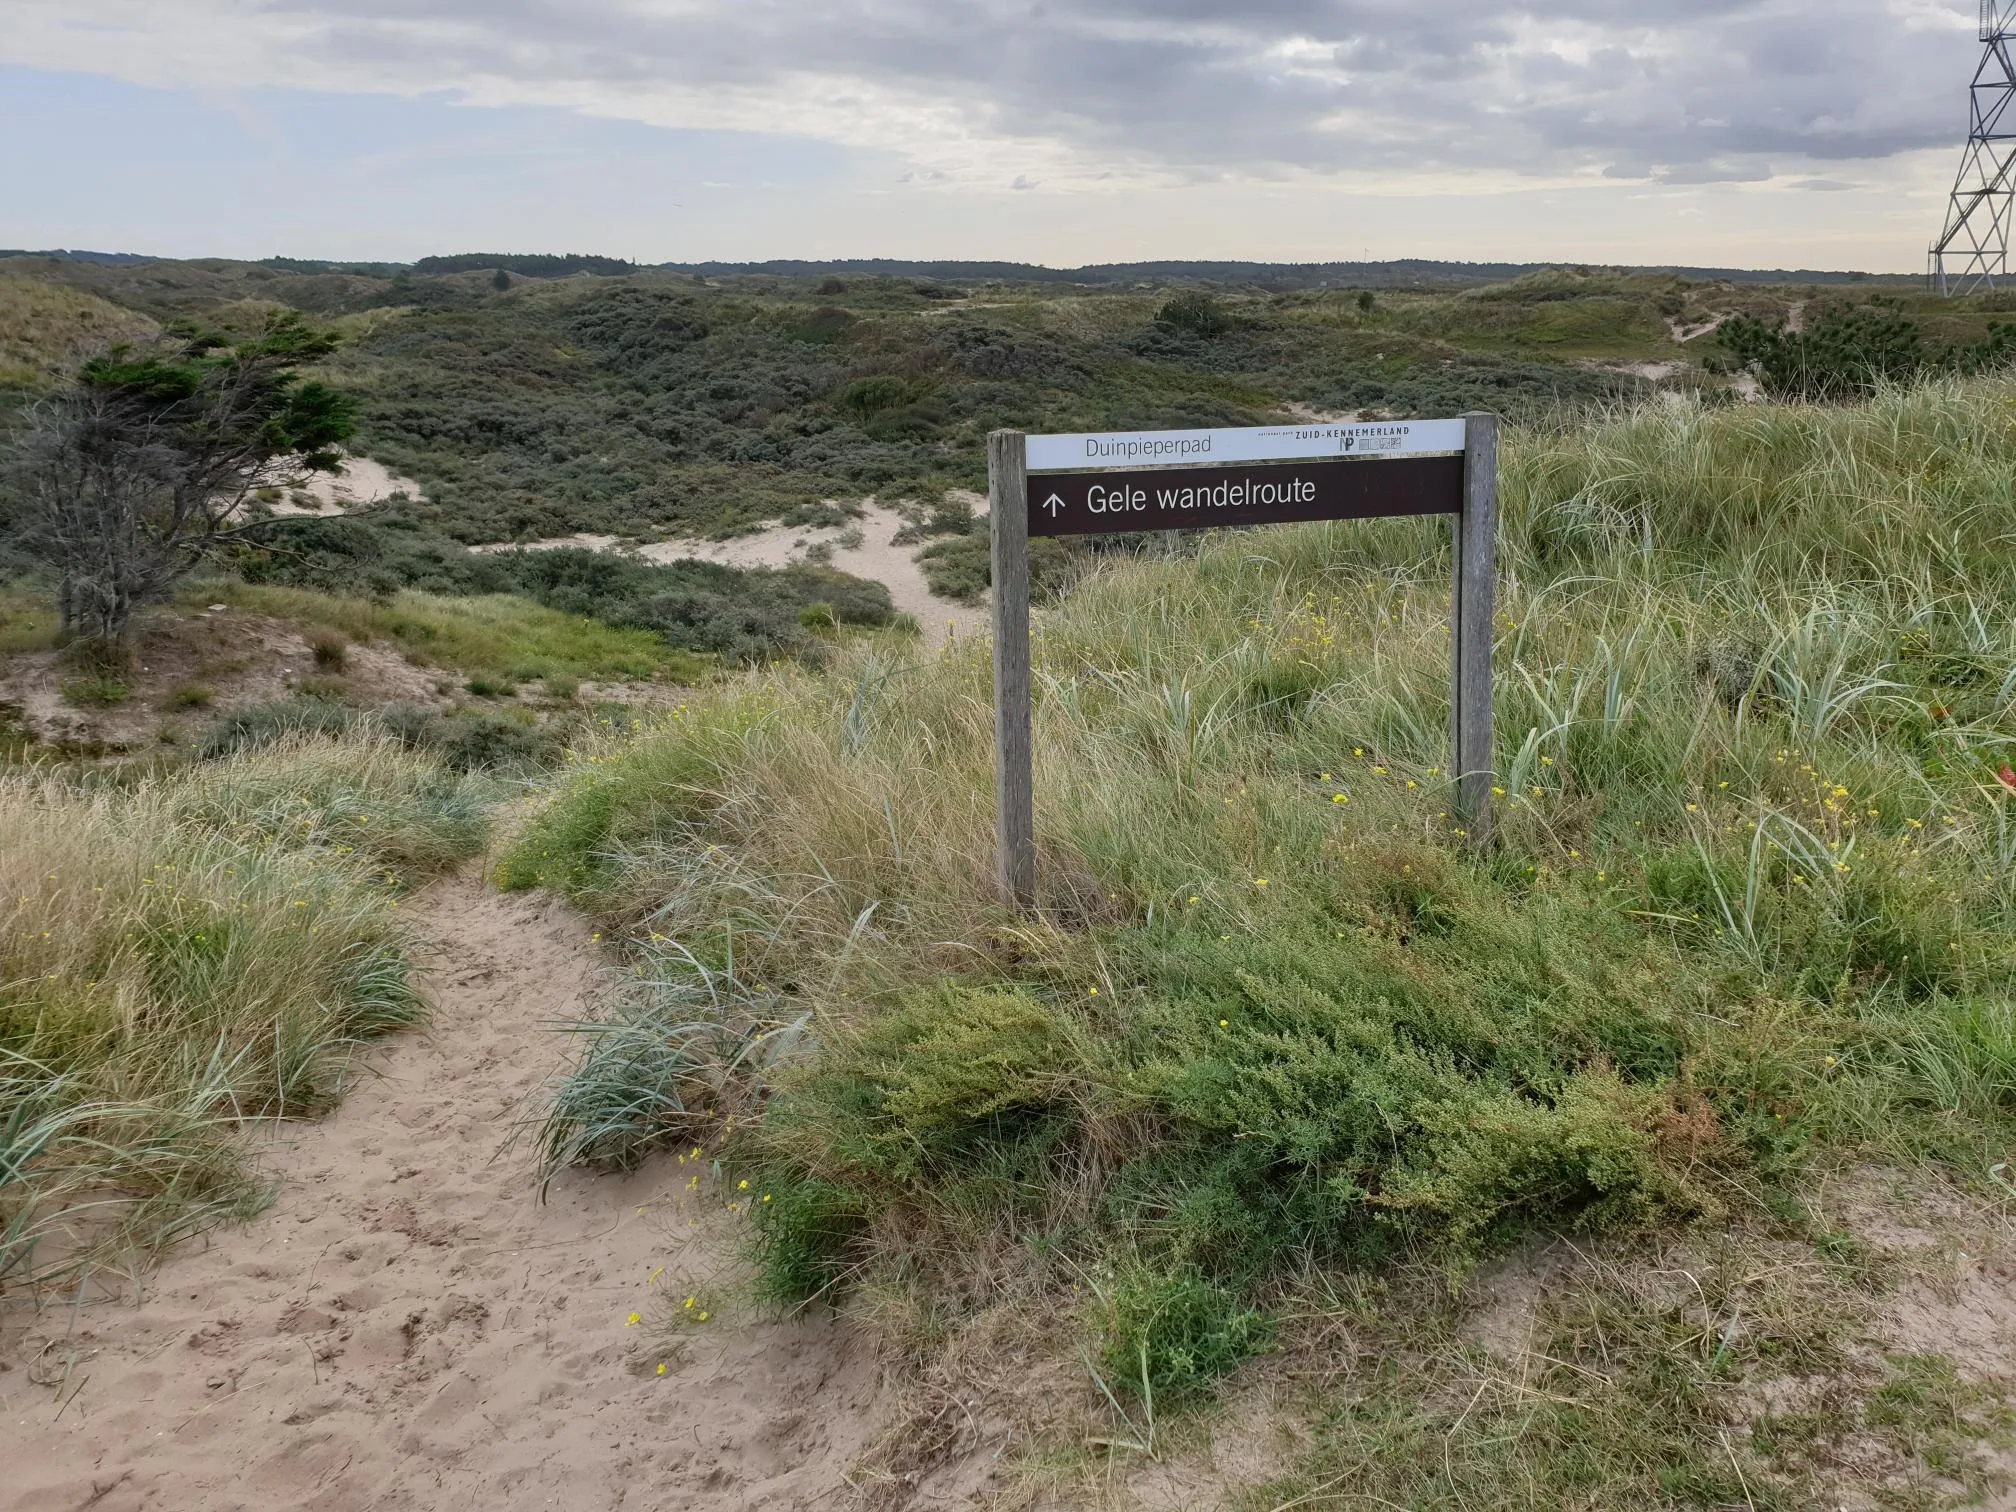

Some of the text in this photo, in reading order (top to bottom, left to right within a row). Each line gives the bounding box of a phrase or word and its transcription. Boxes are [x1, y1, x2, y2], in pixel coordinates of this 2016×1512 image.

[1295, 425, 1410, 439] ZUID-KENNEMERLAND
[1086, 435, 1211, 459] Duinpieperpad
[1087, 477, 1316, 513] Gele wandelroute
